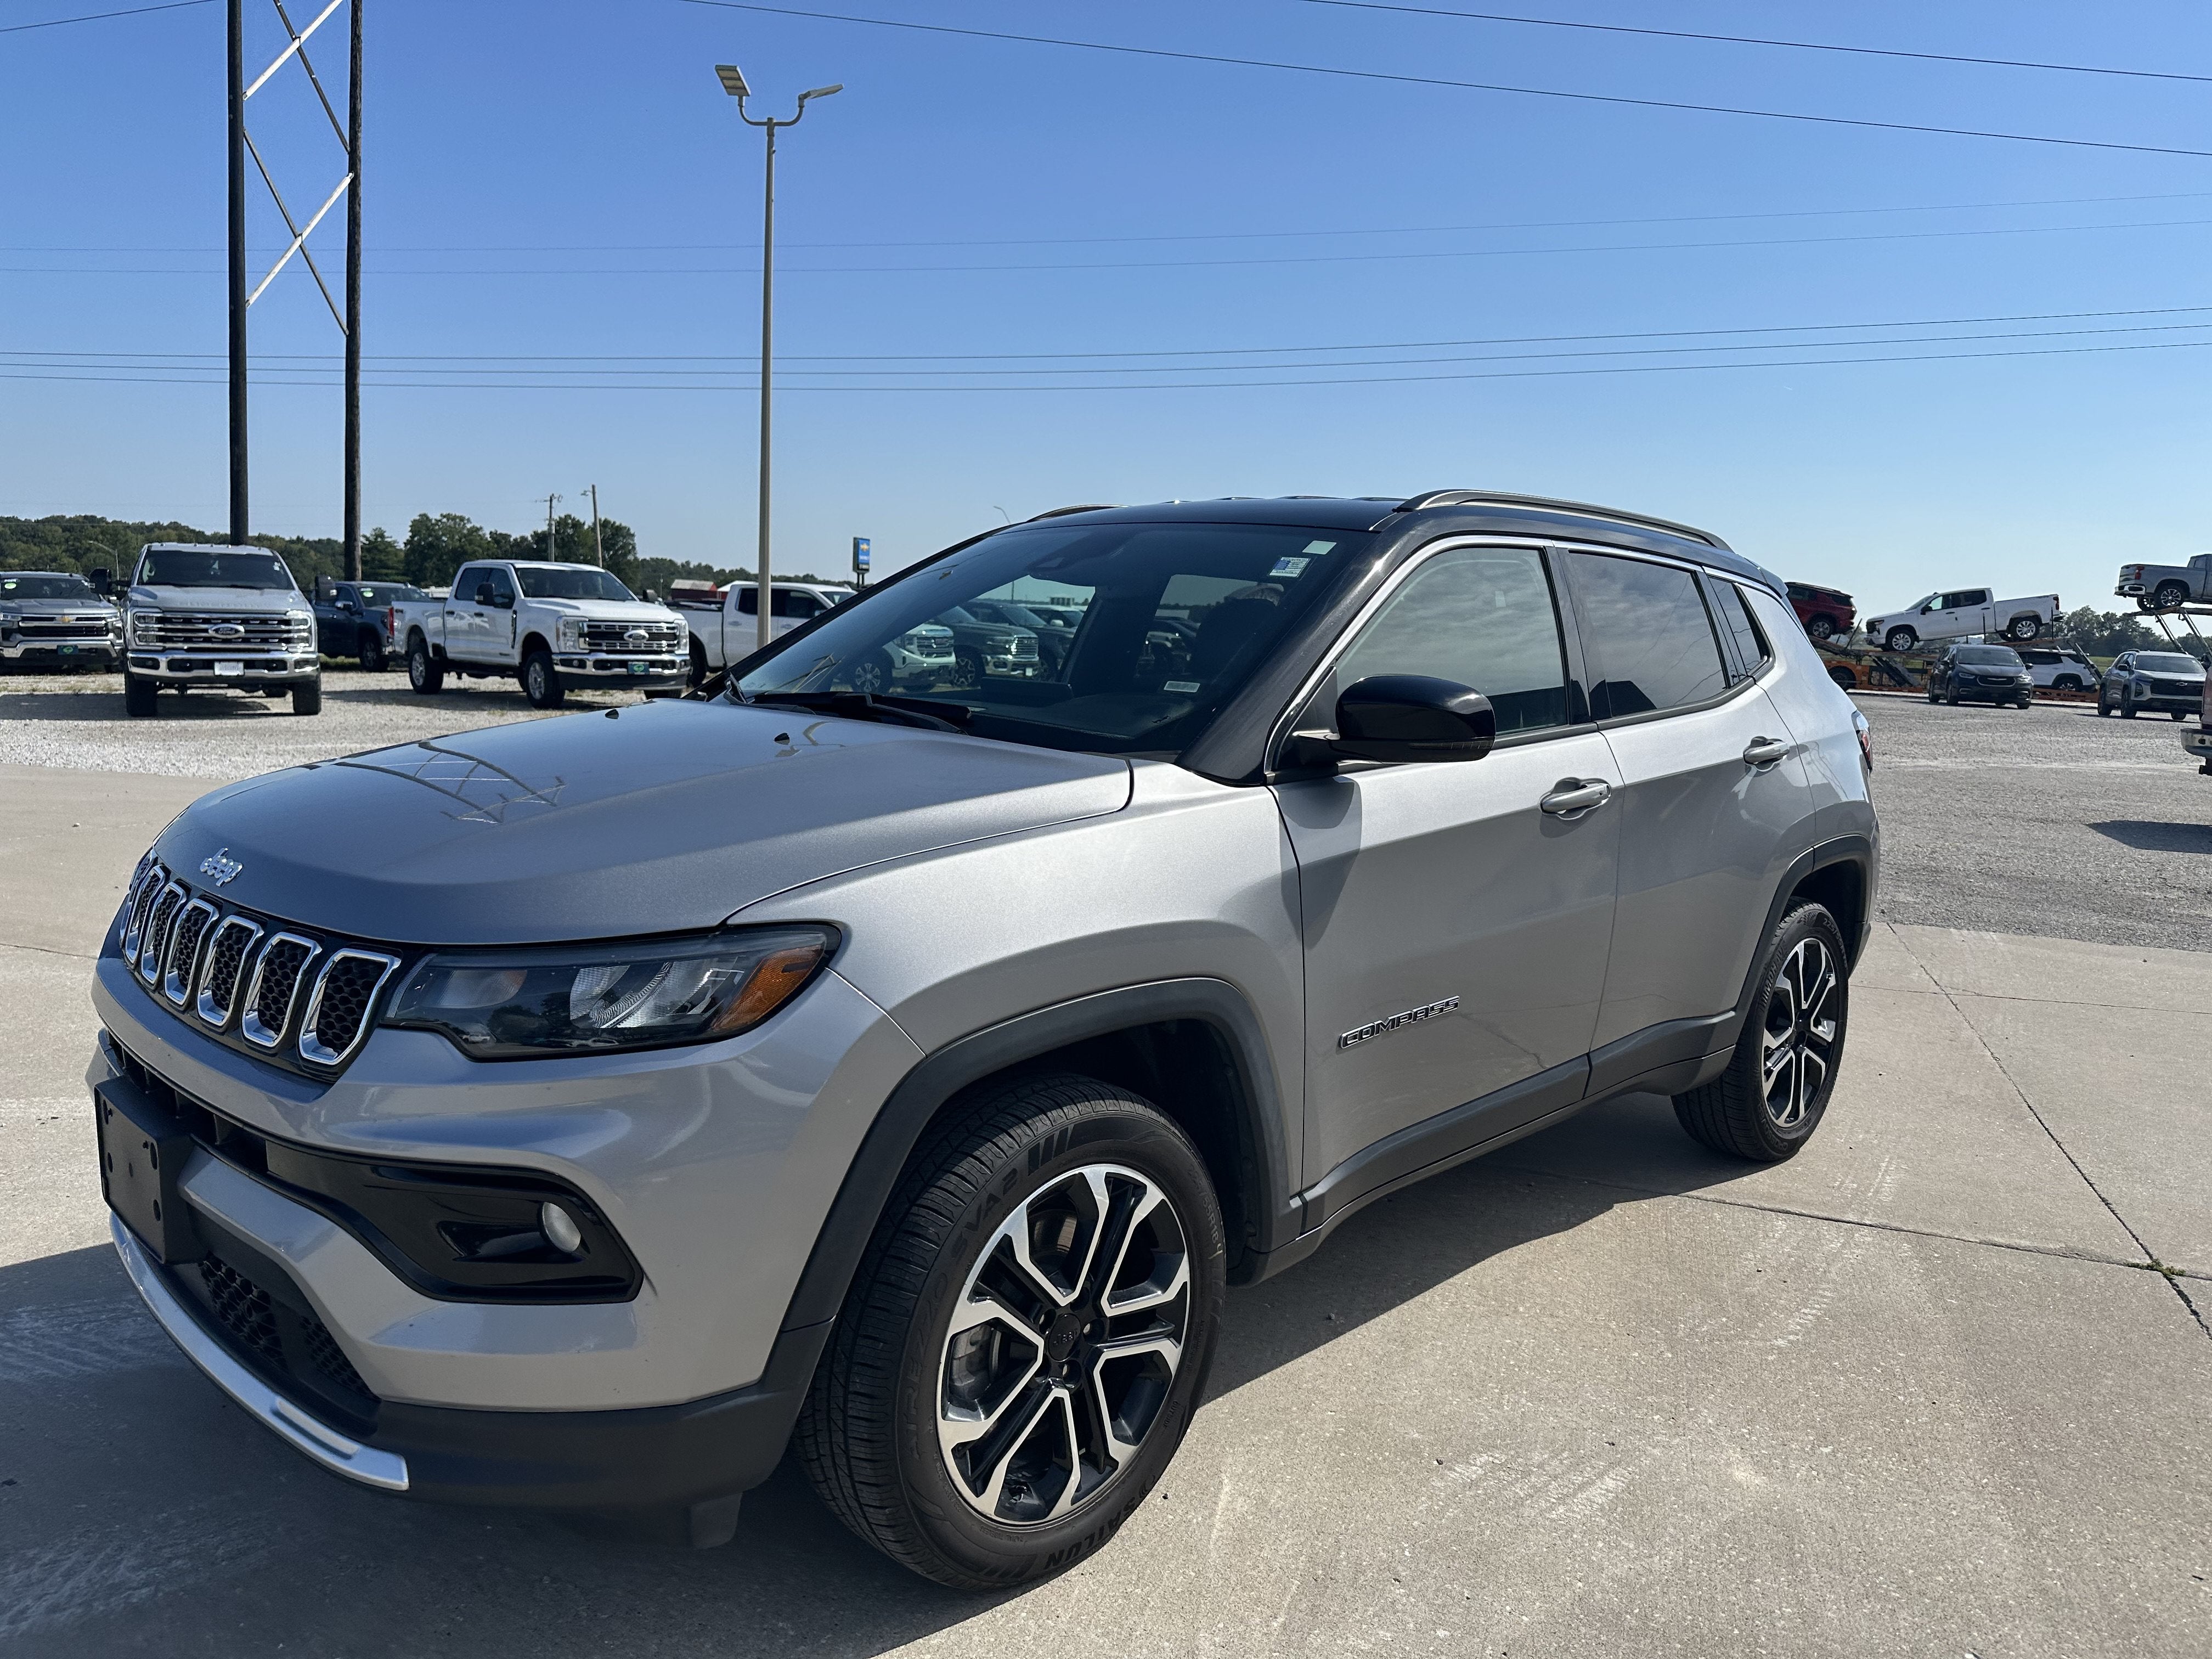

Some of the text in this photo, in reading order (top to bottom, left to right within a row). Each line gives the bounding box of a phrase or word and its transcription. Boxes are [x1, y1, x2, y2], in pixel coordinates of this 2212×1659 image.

[200, 847, 242, 887] Jeep
[1339, 995, 1460, 1049] COMPASS
[1053, 1328, 1080, 1346] Jeep
[1043, 1496, 1137, 1570] SAILUN
